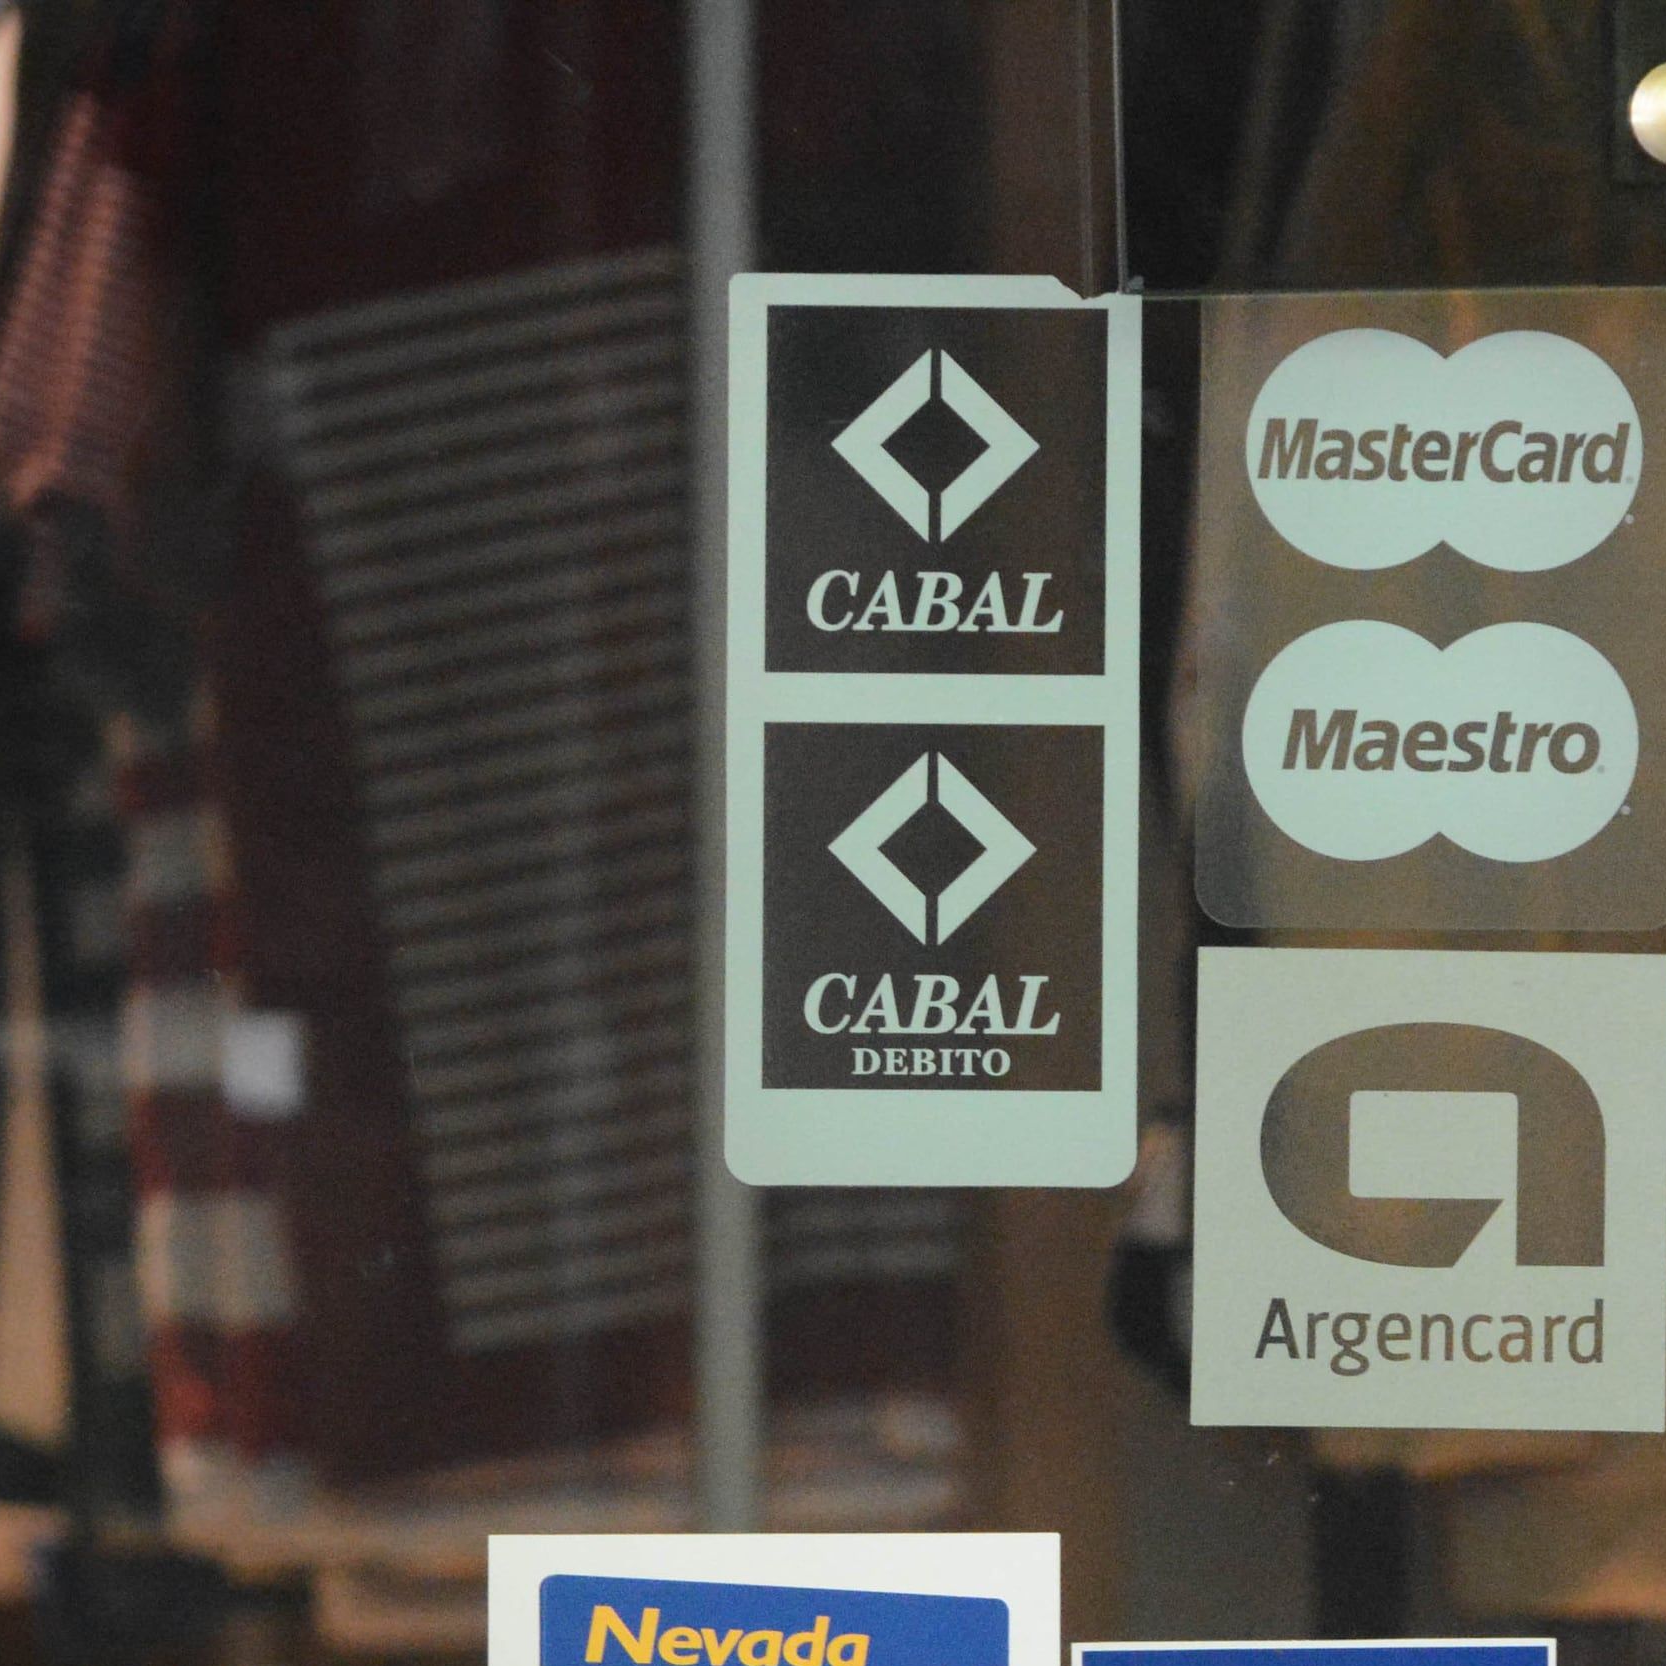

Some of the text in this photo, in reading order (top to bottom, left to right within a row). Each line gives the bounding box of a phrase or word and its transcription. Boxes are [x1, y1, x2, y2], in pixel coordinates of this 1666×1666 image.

[1256, 416, 1631, 484] MasterCard
[805, 570, 1064, 633] CABAL
[1281, 708, 1601, 775] Maestro
[801, 973, 1061, 1036] CABAL
[851, 1046, 1012, 1077] DEBITO
[1255, 1296, 1605, 1376] Argencard
